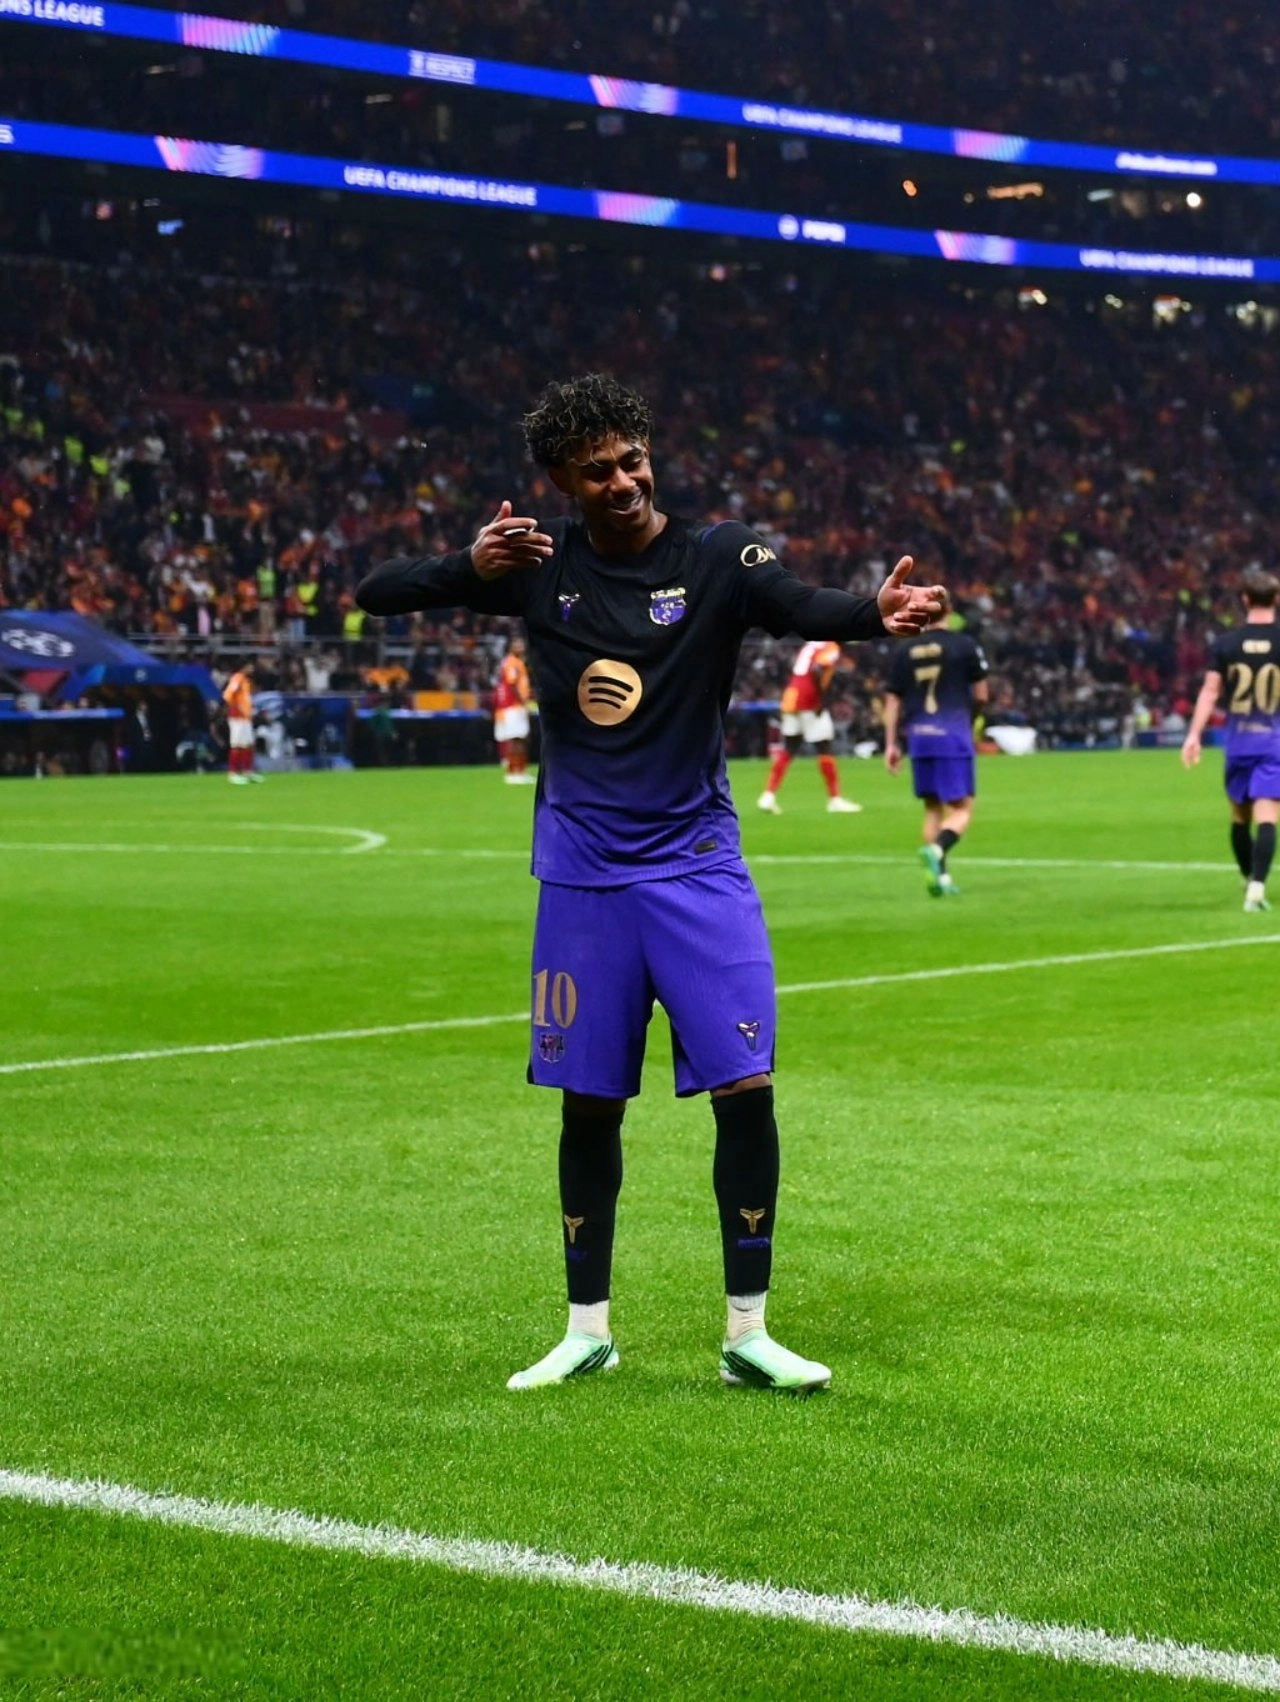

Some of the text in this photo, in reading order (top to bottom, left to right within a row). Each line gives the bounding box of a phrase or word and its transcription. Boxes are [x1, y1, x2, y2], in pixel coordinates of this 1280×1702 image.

[34, 0, 105, 27] LEAGUE
[344, 165, 538, 207] UEFA CHAMPIONS LEAGUE
[914, 664, 941, 714] 7
[533, 968, 578, 1029] 10
